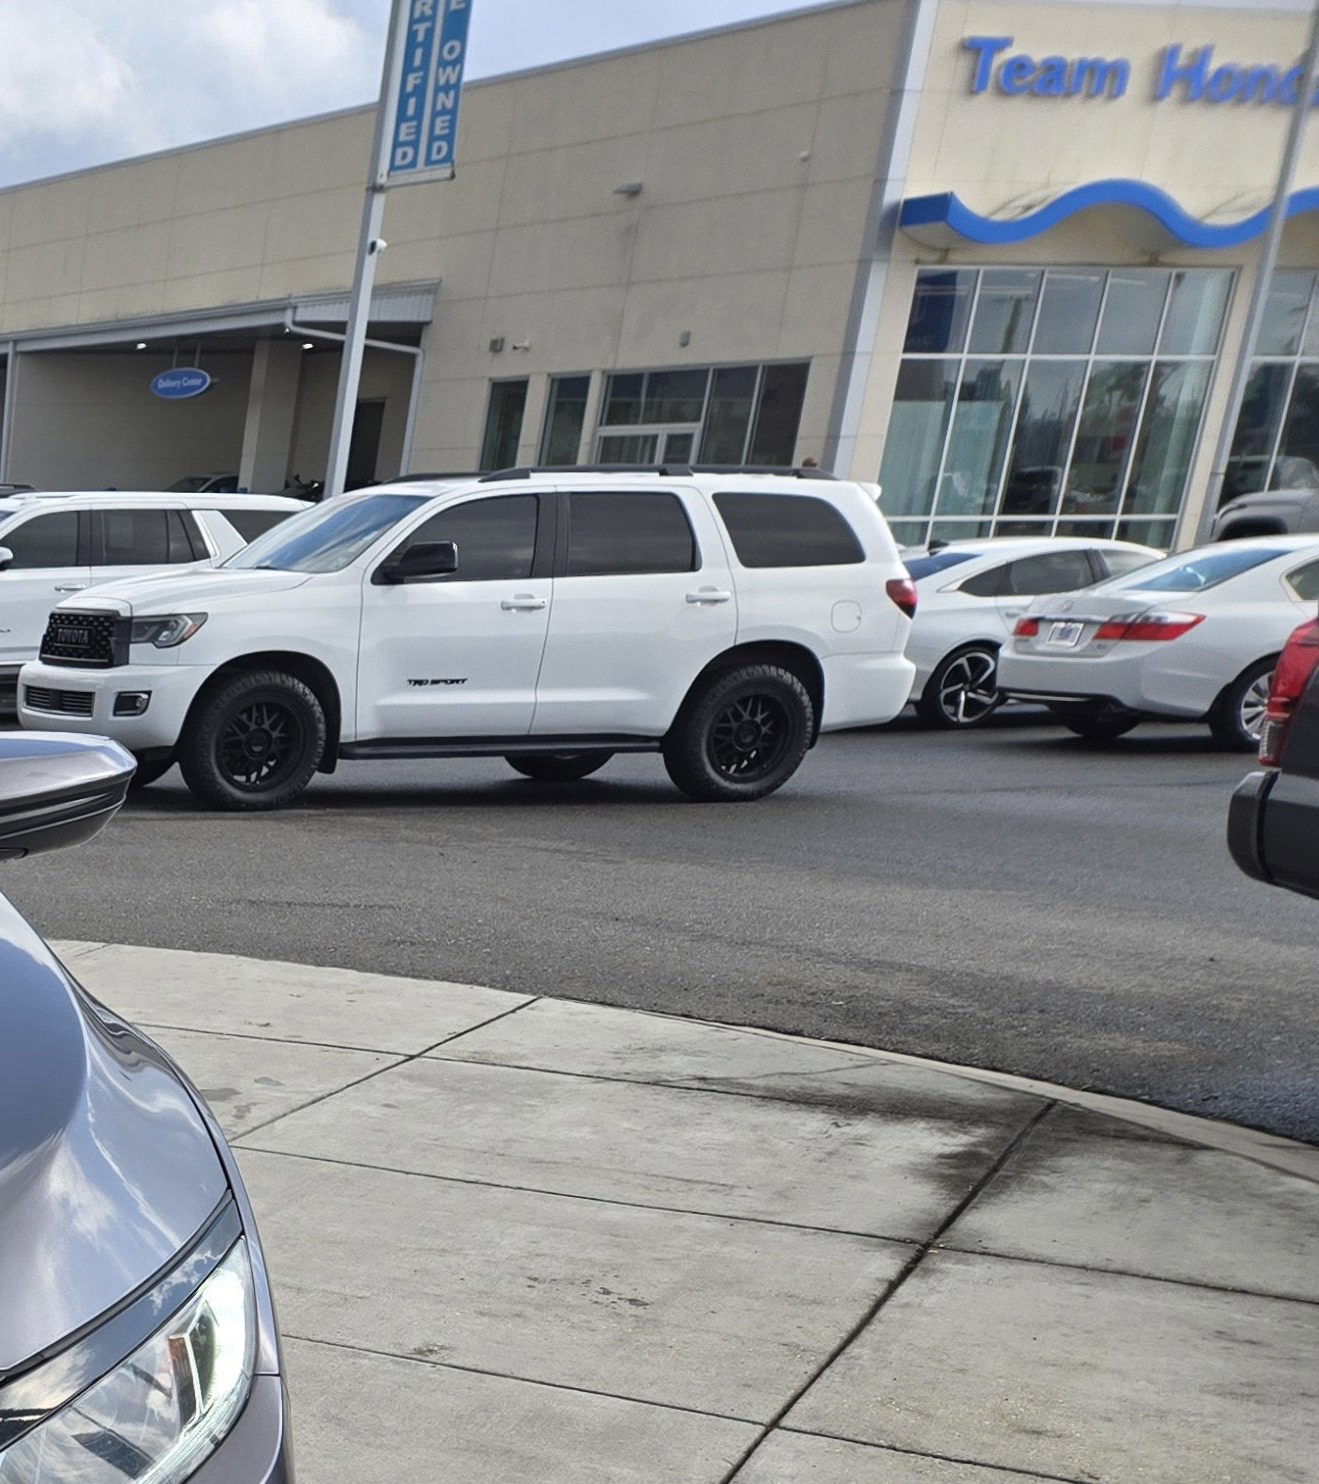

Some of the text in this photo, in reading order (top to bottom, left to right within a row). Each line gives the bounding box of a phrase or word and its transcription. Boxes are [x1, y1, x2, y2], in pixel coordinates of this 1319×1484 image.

[394, 0, 434, 167] RTIFIED
[431, 39, 462, 162] OWNED
[963, 35, 1319, 107] Team Hond
